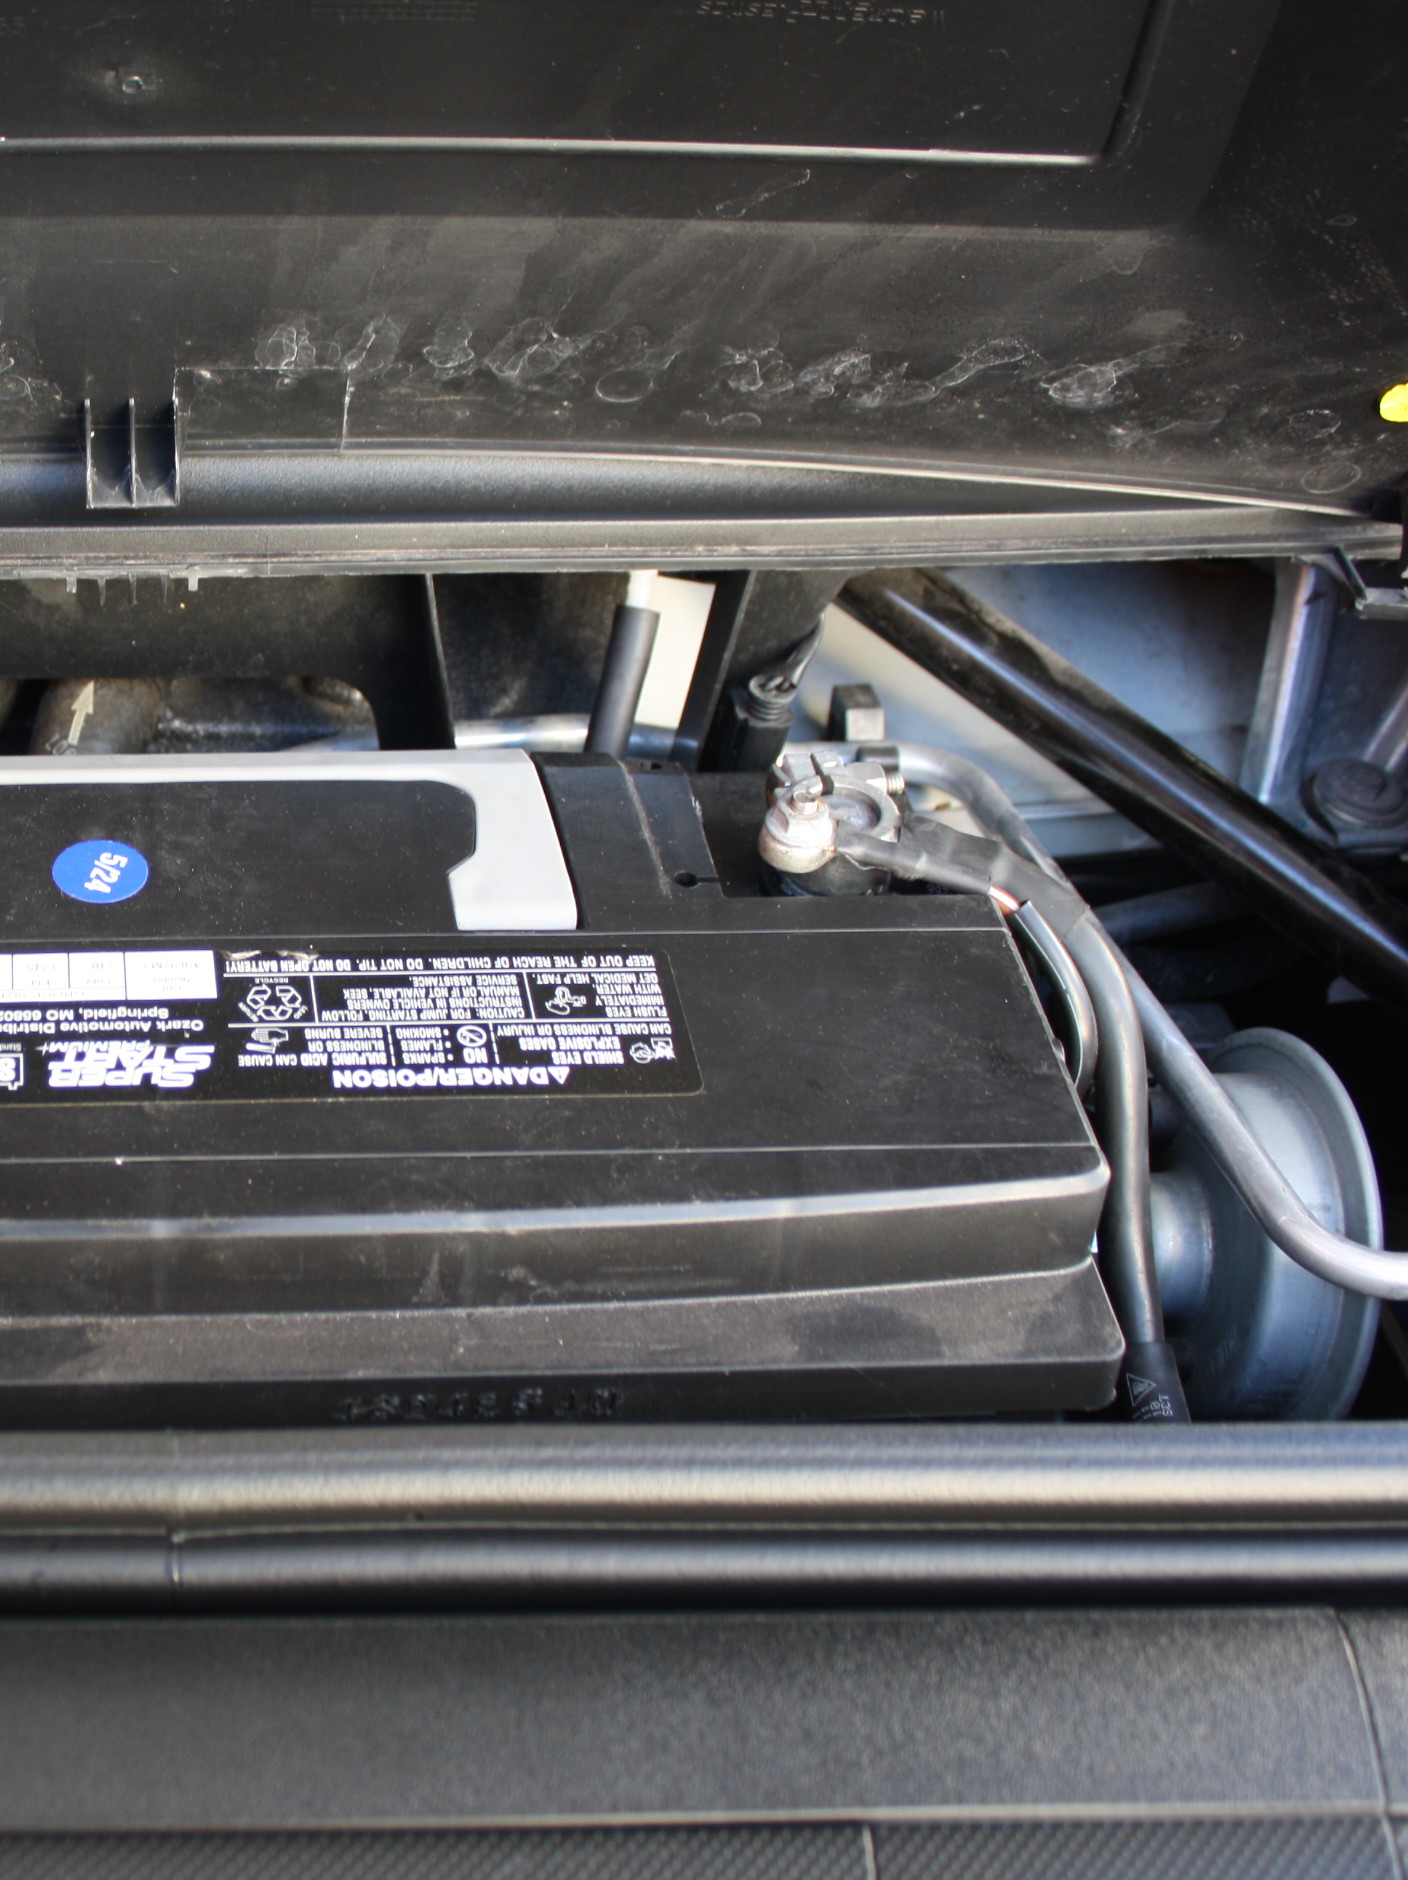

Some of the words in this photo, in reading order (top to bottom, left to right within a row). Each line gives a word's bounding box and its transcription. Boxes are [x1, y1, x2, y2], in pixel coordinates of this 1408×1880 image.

[84, 852, 128, 894] 5/24
[225, 960, 278, 973] BATTERY!
[279, 960, 309, 971] OPEN
[311, 960, 334, 971] NOT
[335, 959, 351, 971] DO
[379, 958, 404, 971] NOT
[408, 958, 423, 970] DO
[494, 956, 509, 969] OF
[512, 956, 551, 968] REACH
[552, 955, 576, 968] THE
[580, 955, 596, 967] OF
[598, 955, 623, 967] OUT
[626, 955, 655, 966] KEEP
[475, 974, 517, 986] SERVICE
[564, 973, 590, 984] HELP
[591, 973, 637, 983] MEDICAL
[638, 972, 658, 983] GET
[343, 989, 368, 999] SEEK
[428, 987, 448, 997] NOT
[450, 987, 459, 997] IF
[462, 986, 476, 997] OR
[477, 986, 520, 996] MANUAL
[634, 984, 661, 994] WITH
[346, 999, 390, 1009] OWNERS
[392, 998, 434, 1009] VEHICLE
[435, 998, 446, 1008] IN
[449, 997, 522, 1008] INSTRUCTIONS
[595, 995, 664, 1006] IMMEDIATELY
[46, 1009, 74, 1020] MO
[78, 1006, 169, 1021] Springfield,
[321, 1010, 363, 1021] FOLLOW
[420, 1008, 448, 1020] JUMP
[450, 1008, 471, 1019] FOR
[475, 1007, 525, 1019] CAUTION:
[605, 1007, 632, 1017] EYES
[633, 1006, 668, 1017] FLUSH
[60, 1020, 151, 1033] Automotive
[157, 1019, 204, 1032] Ozark
[496, 1024, 535, 1036] INJURY
[536, 1024, 552, 1036] OR
[554, 1023, 612, 1036] BLINDNESS
[614, 1023, 648, 1034] CAUSE
[650, 1023, 672, 1034] CAN
[304, 1028, 341, 1039] BURNS
[343, 1027, 383, 1039] SEVERE
[395, 1027, 442, 1039] SMOKING
[308, 1041, 324, 1052] OR
[325, 1040, 385, 1051] BLINDNESS
[400, 1040, 443, 1051] FLAMES
[518, 1037, 556, 1050] GASES
[558, 1036, 620, 1050] EXPLOSIVE
[47, 1045, 215, 1070] START
[238, 1055, 273, 1067] CAUSE
[275, 1054, 297, 1066] CAN
[300, 1053, 328, 1066] ACID
[332, 1052, 387, 1066] SULFURIC
[402, 1052, 445, 1064] SPARKS
[463, 1048, 488, 1064] NO
[551, 1051, 582, 1064] EYES
[583, 1051, 624, 1064] SHIELD
[48, 1065, 196, 1088] SUPER
[332, 1066, 550, 1088] DANGER/POISON
